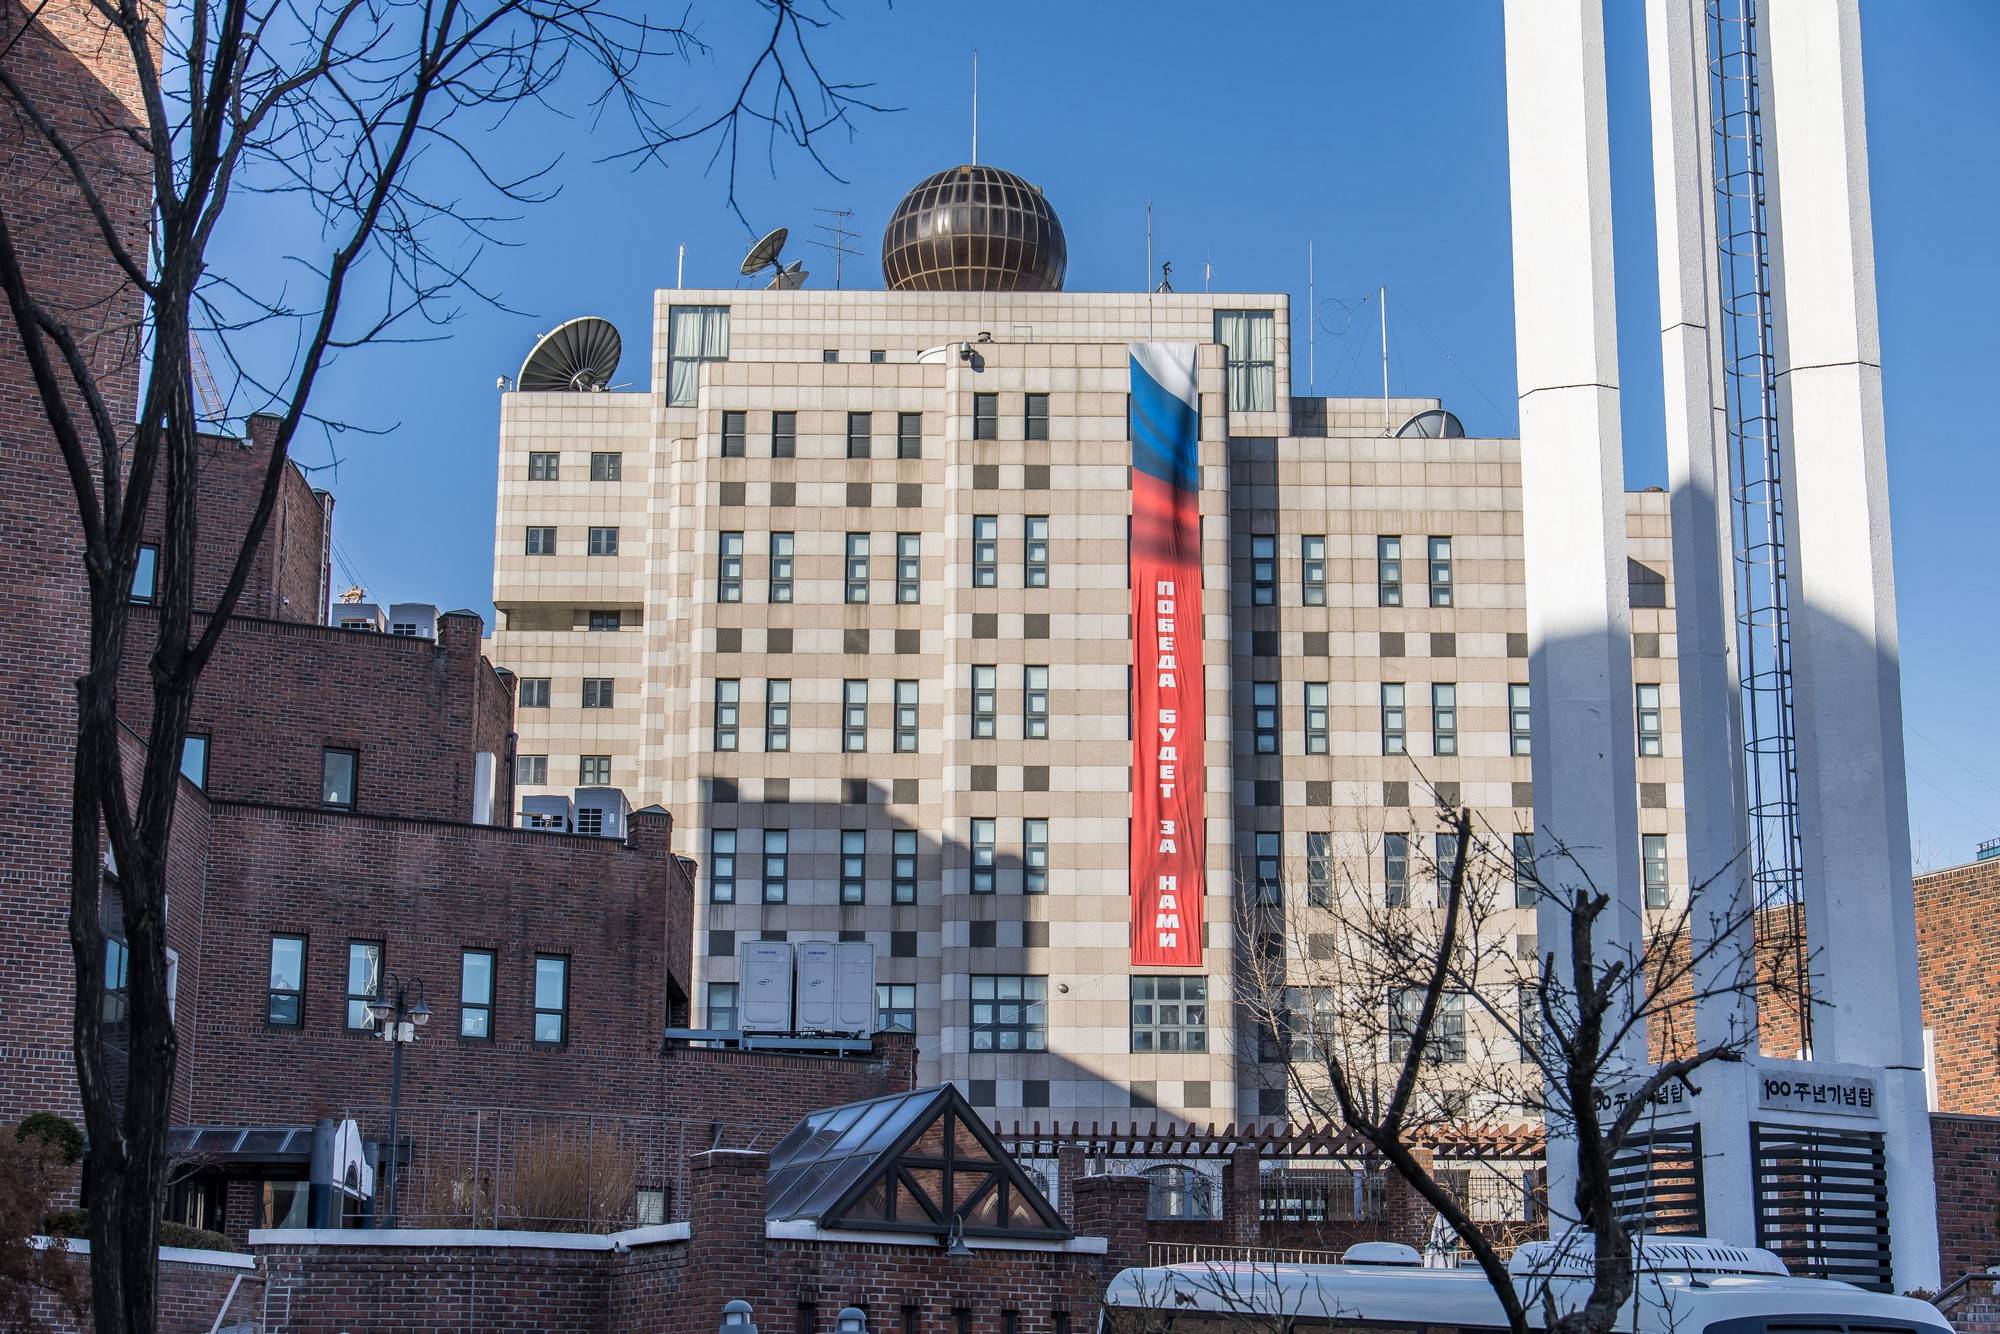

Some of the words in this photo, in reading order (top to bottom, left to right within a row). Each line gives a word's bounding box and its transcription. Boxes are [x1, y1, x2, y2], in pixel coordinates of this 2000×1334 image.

[1157, 581, 1177, 688] ПОБЕДА
[1157, 709, 1178, 798] БУДЕТ
[1159, 820, 1177, 854] ЗА
[1155, 875, 1180, 948] НАМИ
